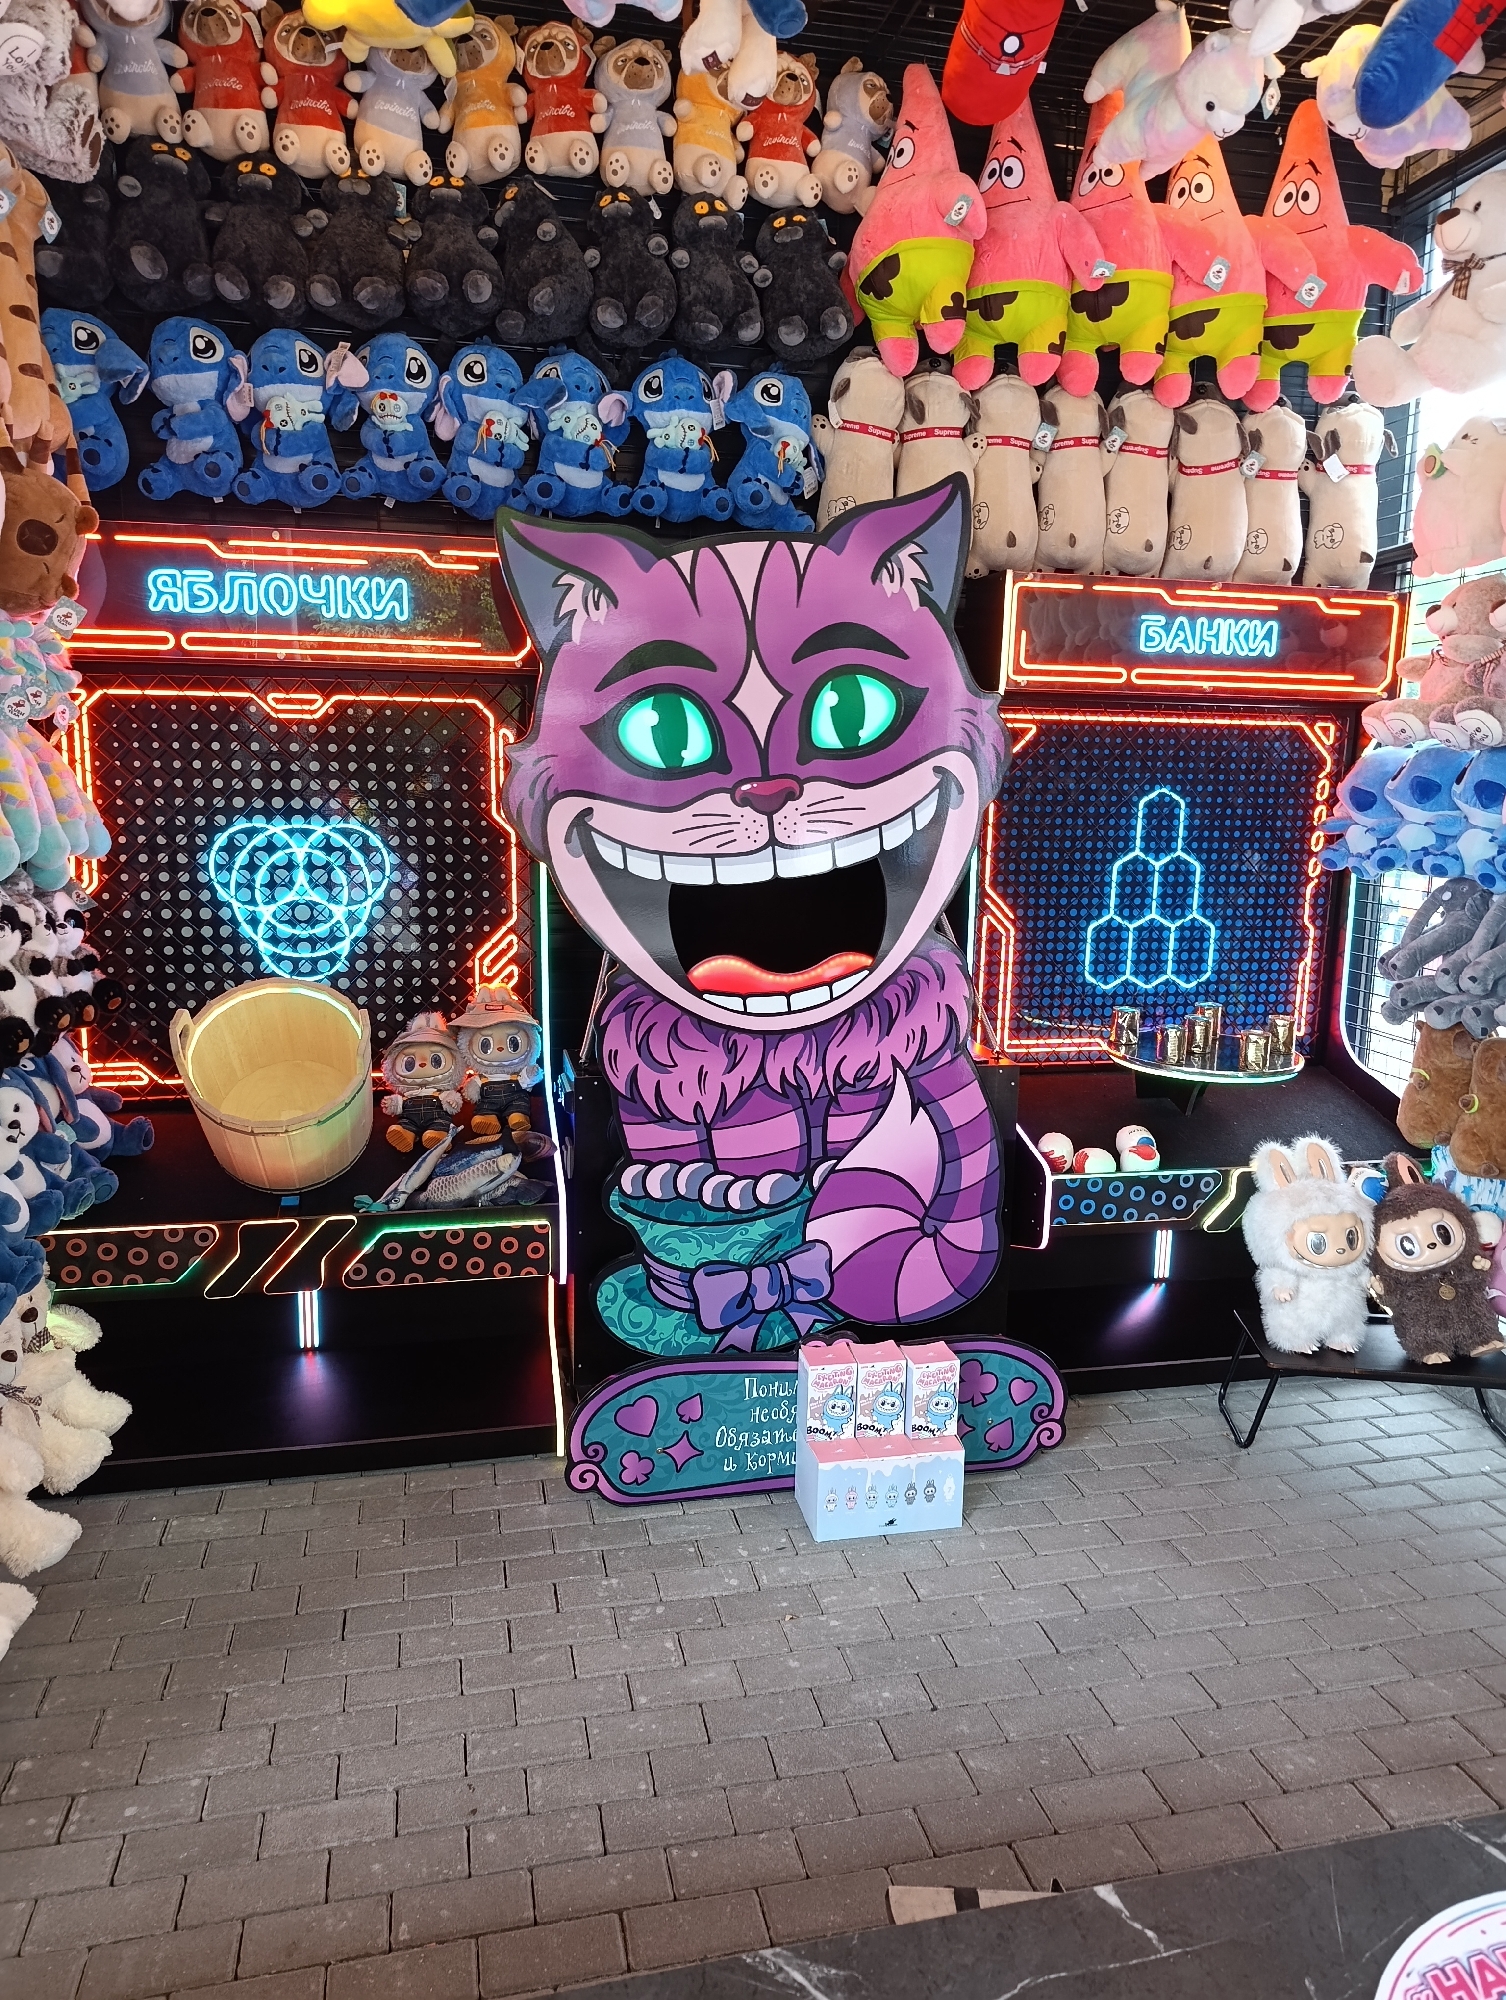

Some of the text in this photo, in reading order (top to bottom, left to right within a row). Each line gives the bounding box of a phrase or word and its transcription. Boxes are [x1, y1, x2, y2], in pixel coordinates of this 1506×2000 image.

[933, 428, 960, 437] Supreme
[147, 568, 409, 622] ЯБЛОЧКИ
[1139, 614, 1279, 658] БАНКИ
